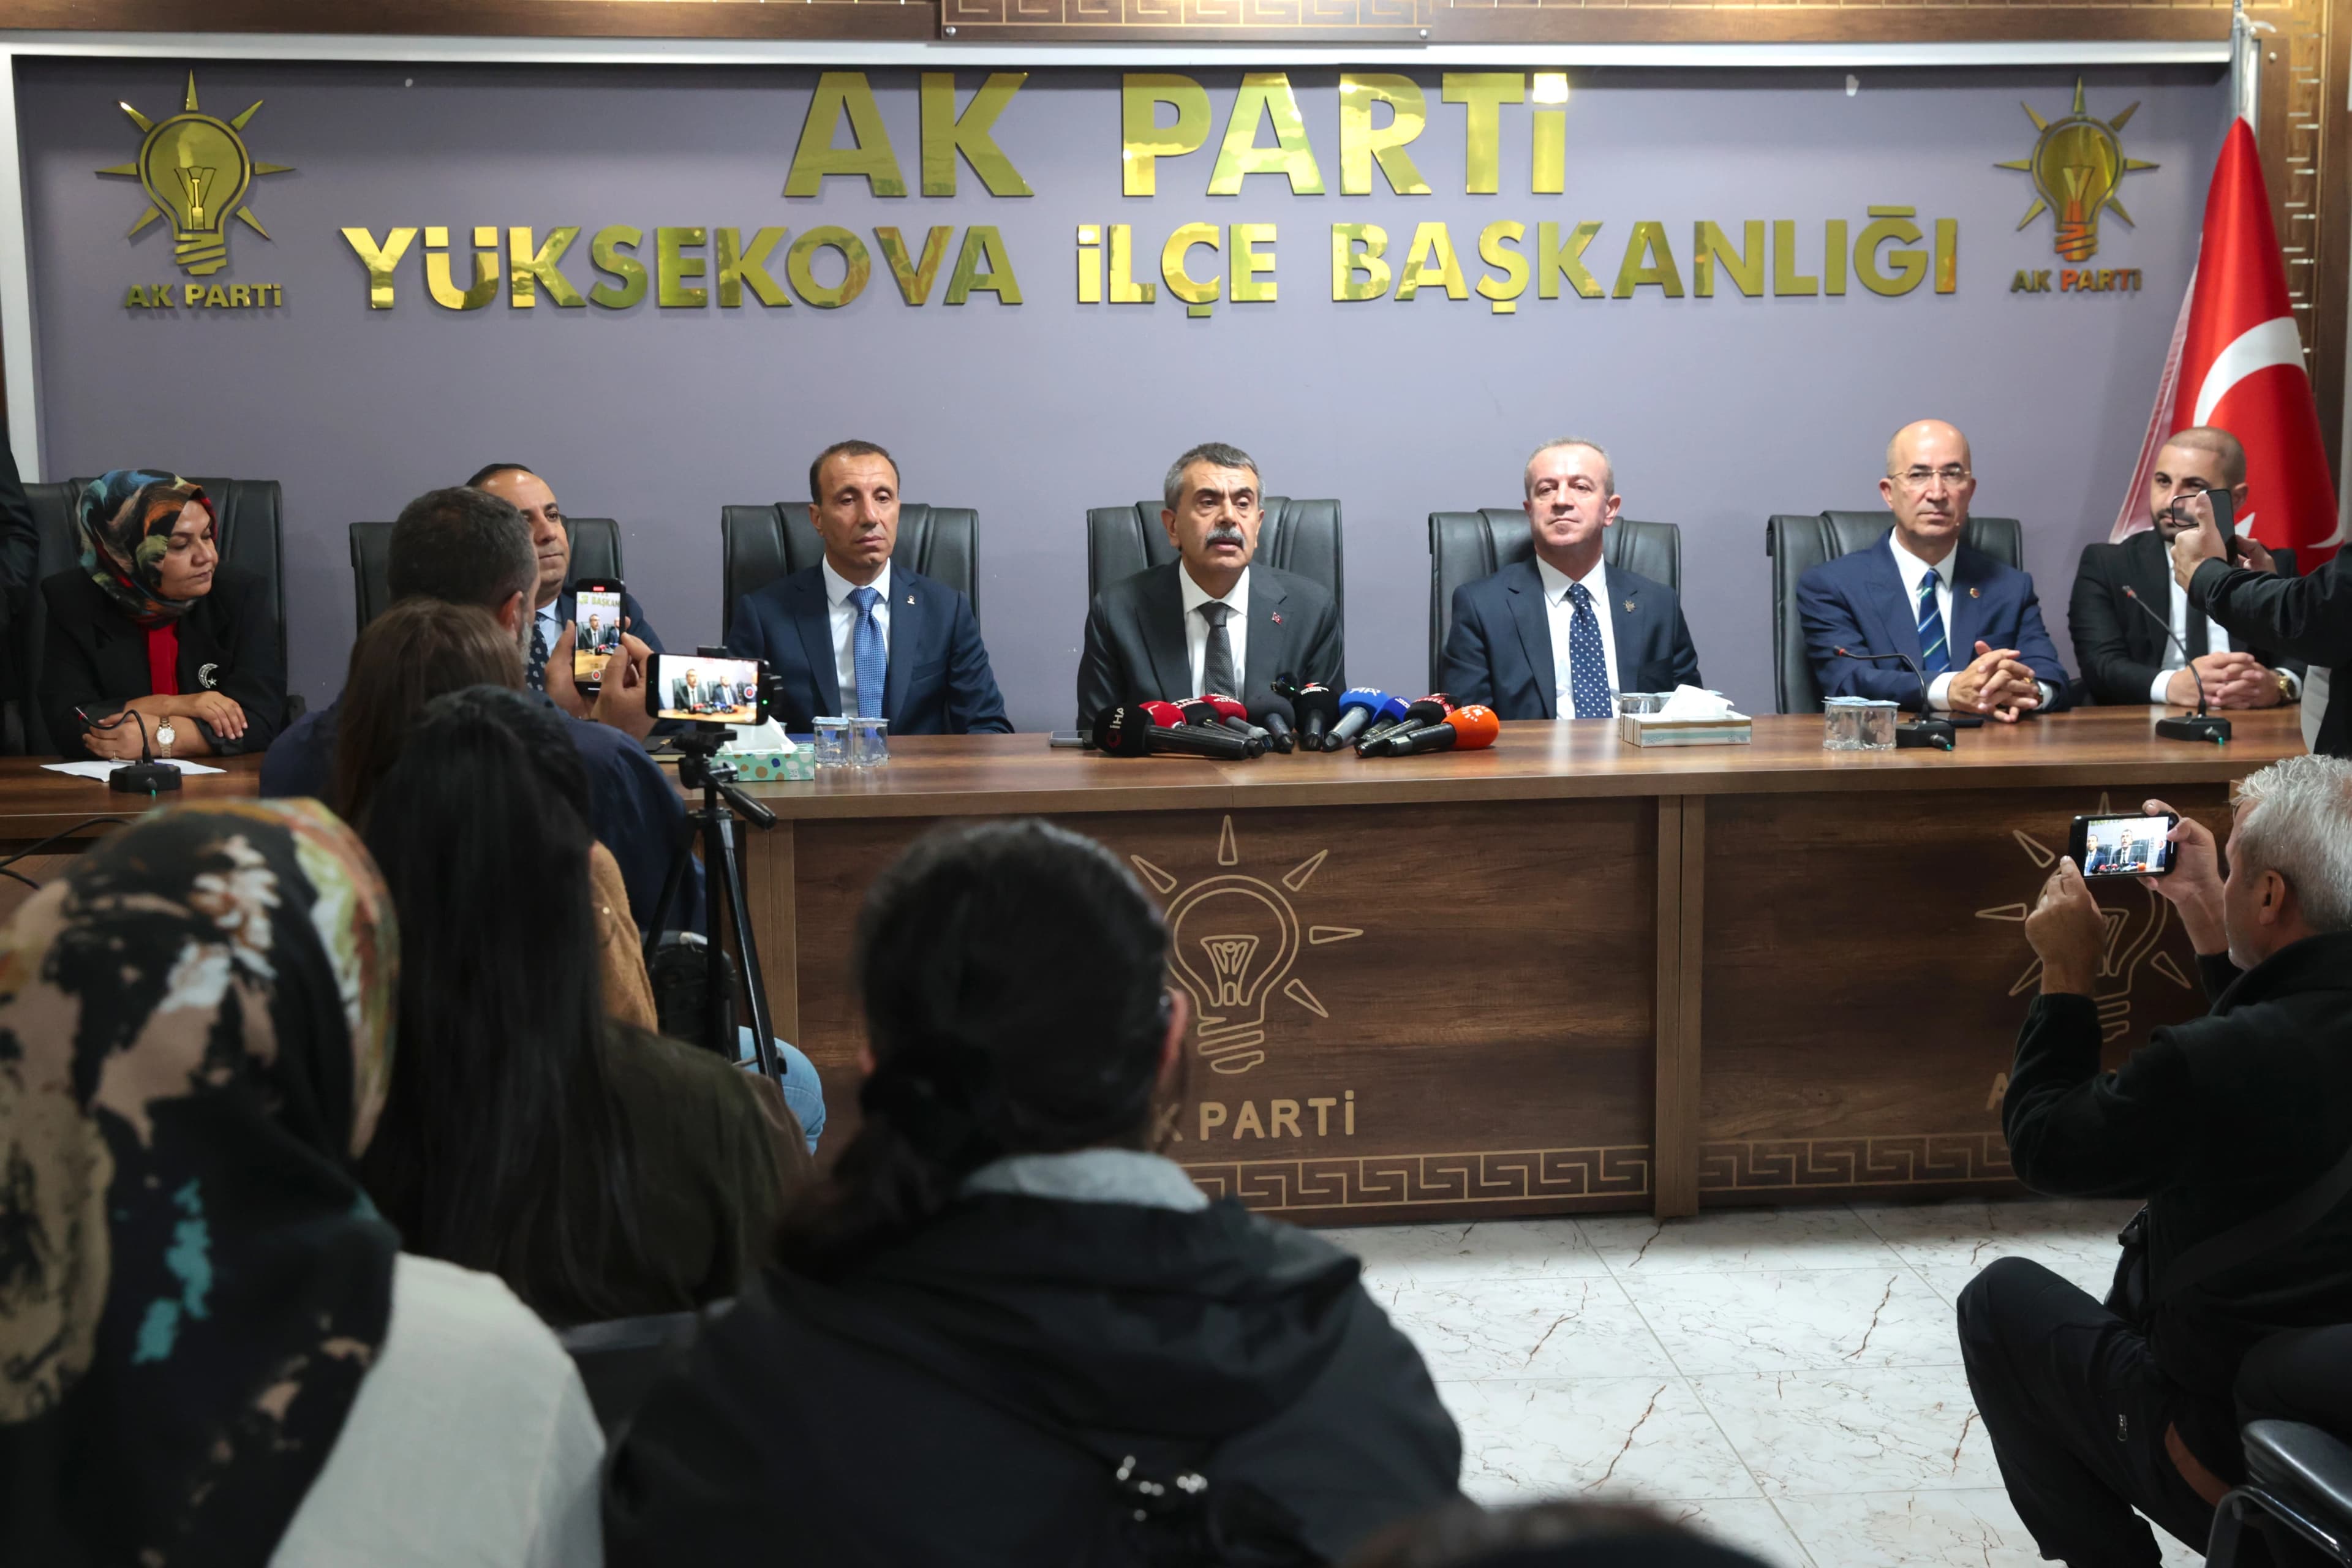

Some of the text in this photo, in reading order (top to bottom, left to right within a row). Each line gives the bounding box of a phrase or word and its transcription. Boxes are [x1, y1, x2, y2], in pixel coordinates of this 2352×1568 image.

[782, 72, 1035, 197] AK
[341, 222, 1024, 311] YÜKSEKOVA
[1330, 205, 1958, 314] BAŞKANLIĞI
[2011, 269, 2052, 293] AK
[126, 284, 175, 307] AK
